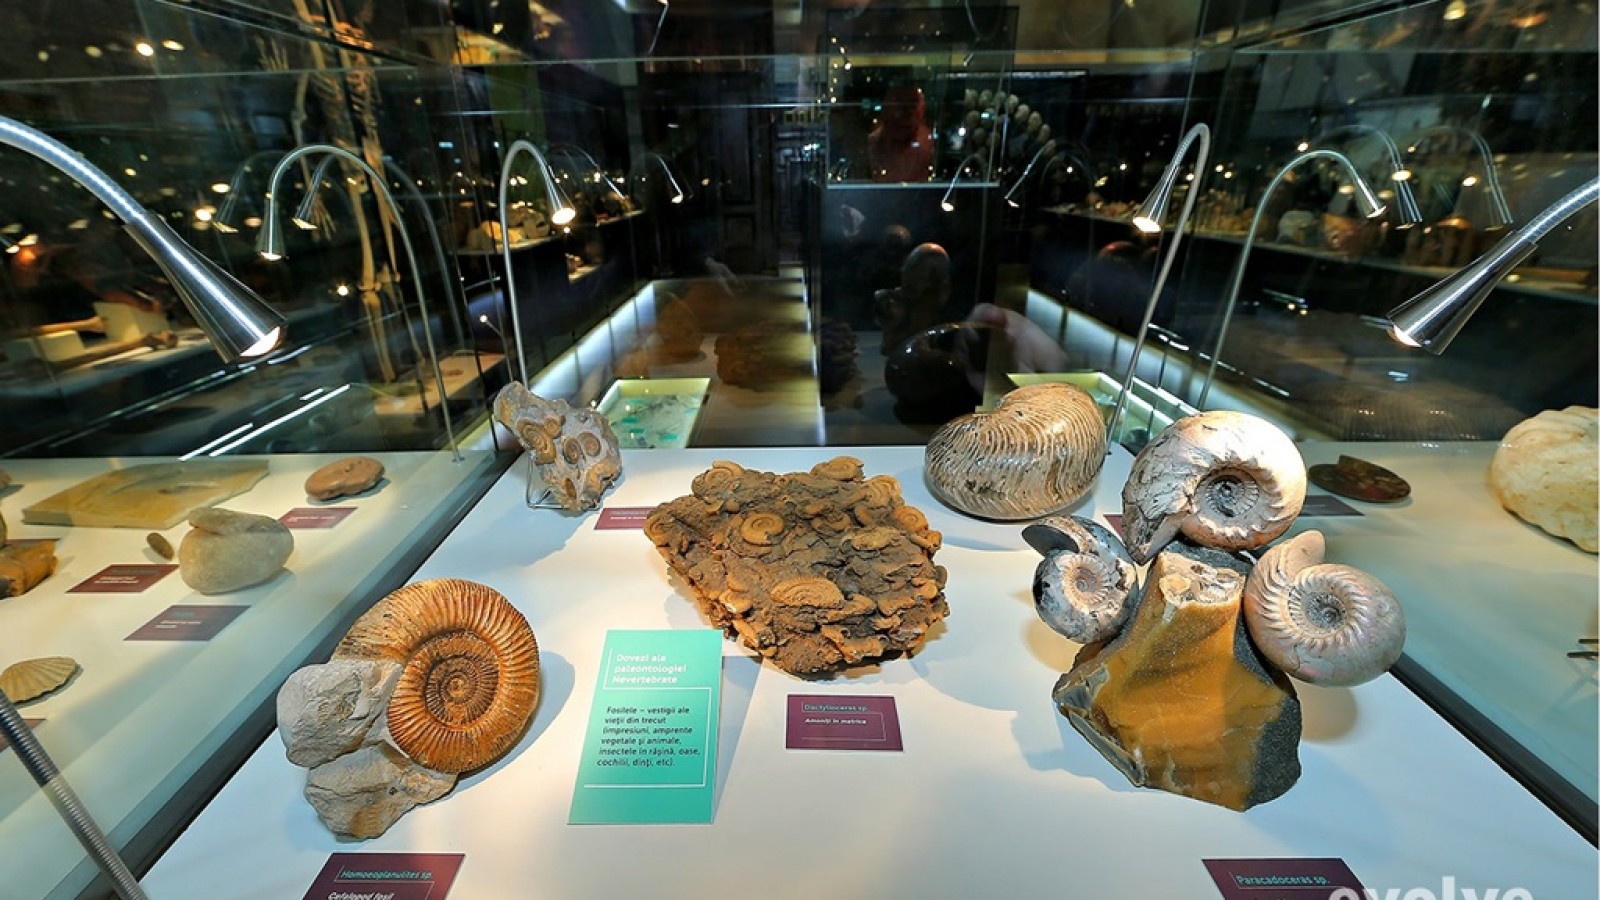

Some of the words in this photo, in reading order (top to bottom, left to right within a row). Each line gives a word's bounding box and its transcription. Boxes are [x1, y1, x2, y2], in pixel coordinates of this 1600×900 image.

[617, 654, 649, 662] Dovezi
[651, 654, 666, 662] ale
[615, 664, 687, 674] paleontologiei
[613, 676, 678, 684] Nevertebrate
[606, 706, 637, 714] Fosilele
[647, 706, 675, 715] vestigii
[677, 706, 689, 714] ale
[626, 716, 640, 724] din
[602, 727, 650, 735] (impresiuni,
[653, 727, 692, 735] amprente
[601, 737, 637, 745] vegetale
[647, 737, 682, 745] animale,
[599, 747, 637, 755] insectele
[678, 748, 700, 756] oase,
[596, 758, 630, 767] cochilii,
